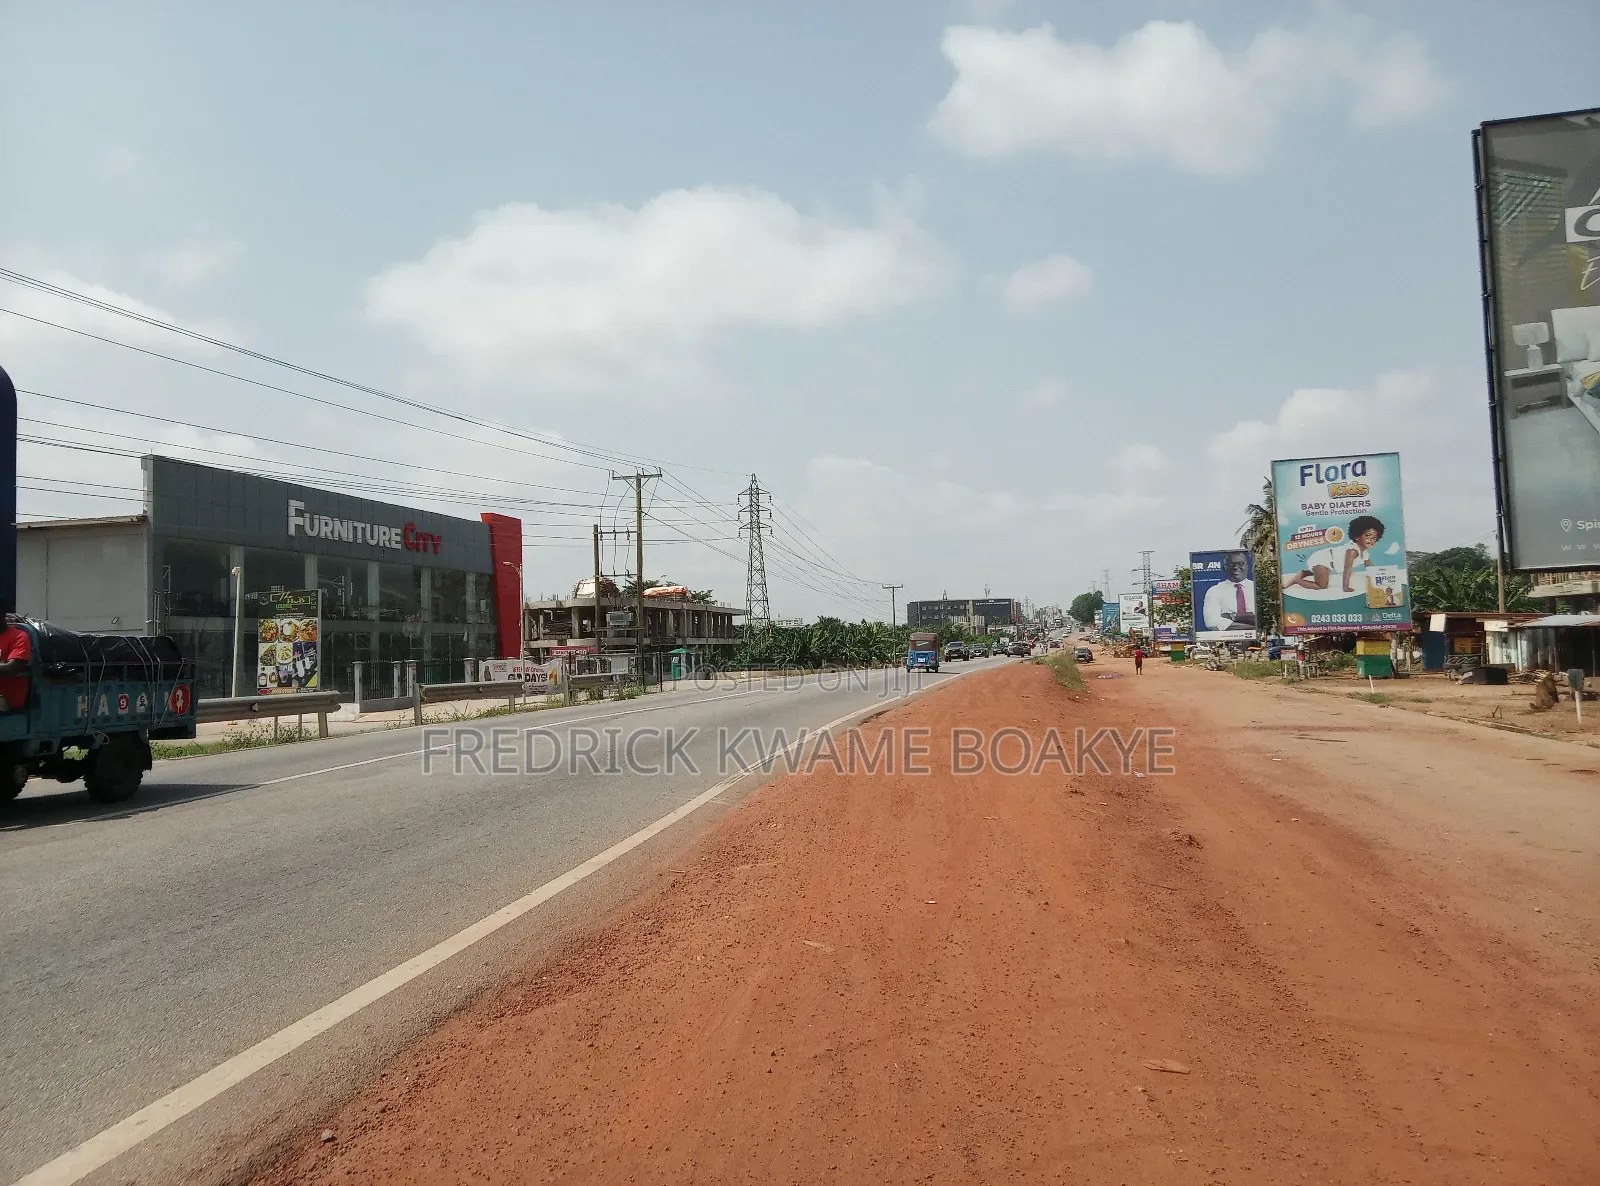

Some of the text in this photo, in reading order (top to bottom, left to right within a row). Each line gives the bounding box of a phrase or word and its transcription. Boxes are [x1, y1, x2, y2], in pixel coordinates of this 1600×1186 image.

[1300, 460, 1367, 486] Flora
[1327, 481, 1369, 499] Kids
[1301, 500, 1371, 510] BABY DIAPERS
[1330, 508, 1367, 516] Protection
[288, 499, 442, 556] FURNITURE CITY
[1302, 531, 1323, 539] HOURS
[1287, 538, 1324, 550] DRYNESS
[1311, 613, 1362, 623] 0243 033 033
